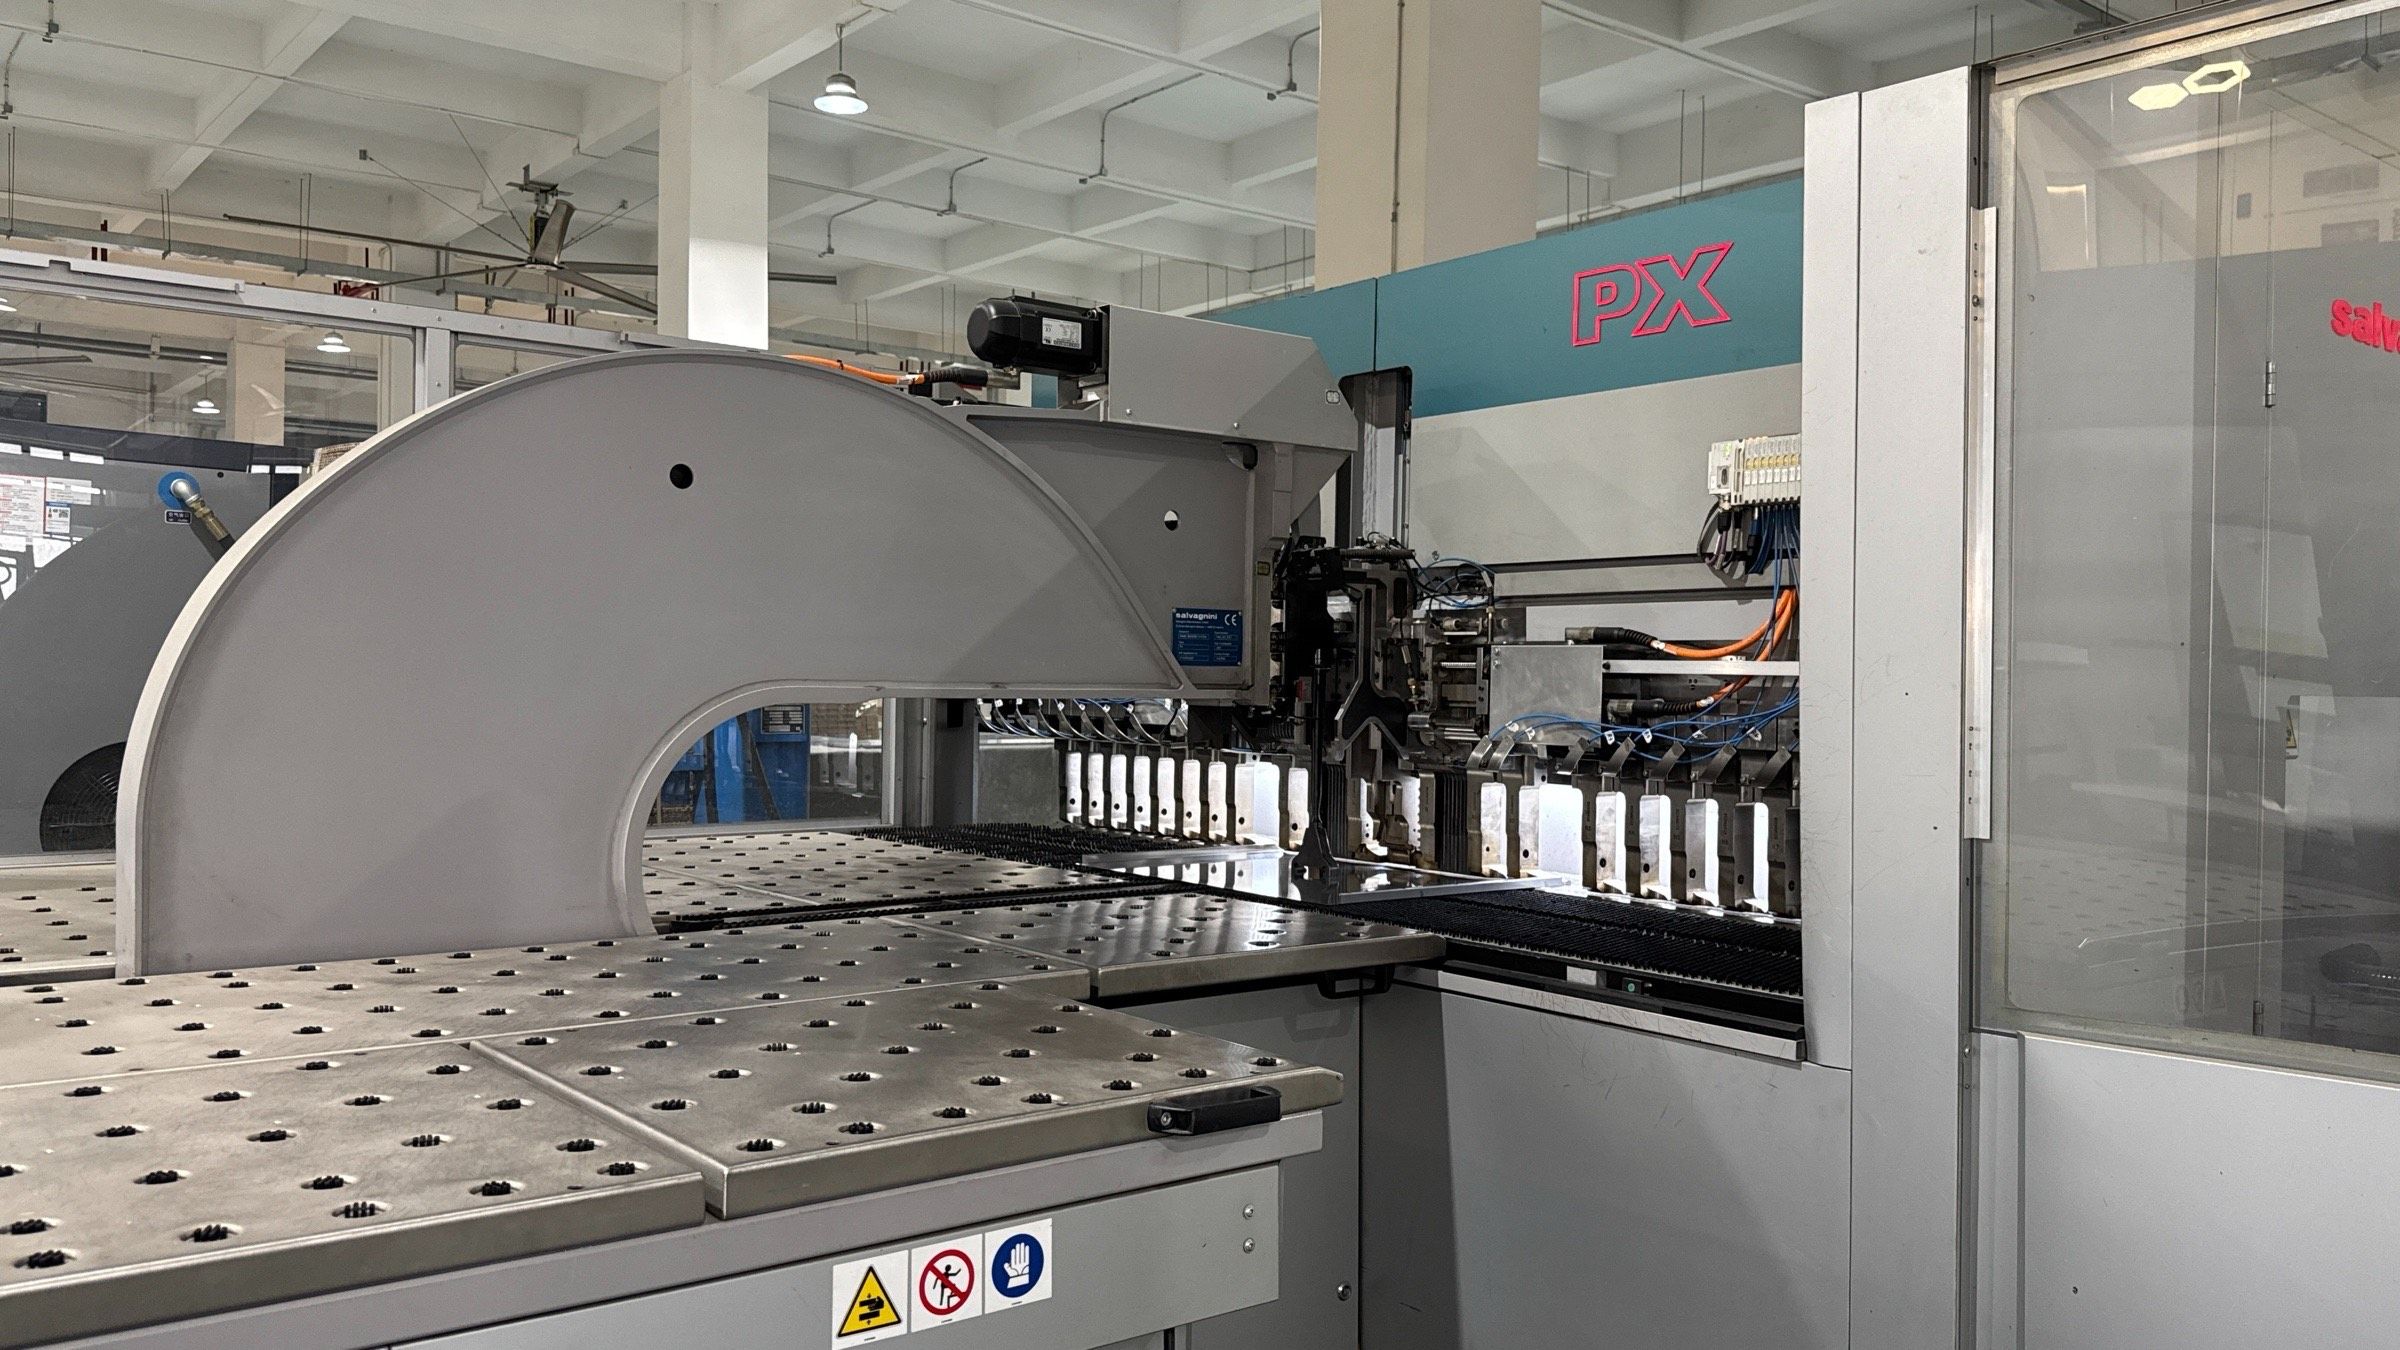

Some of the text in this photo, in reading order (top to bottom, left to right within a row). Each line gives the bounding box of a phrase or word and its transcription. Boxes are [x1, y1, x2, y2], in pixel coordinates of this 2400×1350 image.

[1572, 241, 1734, 346] PX
[2331, 299, 2400, 354] salv
[1175, 612, 1237, 626] salvagnini CE
